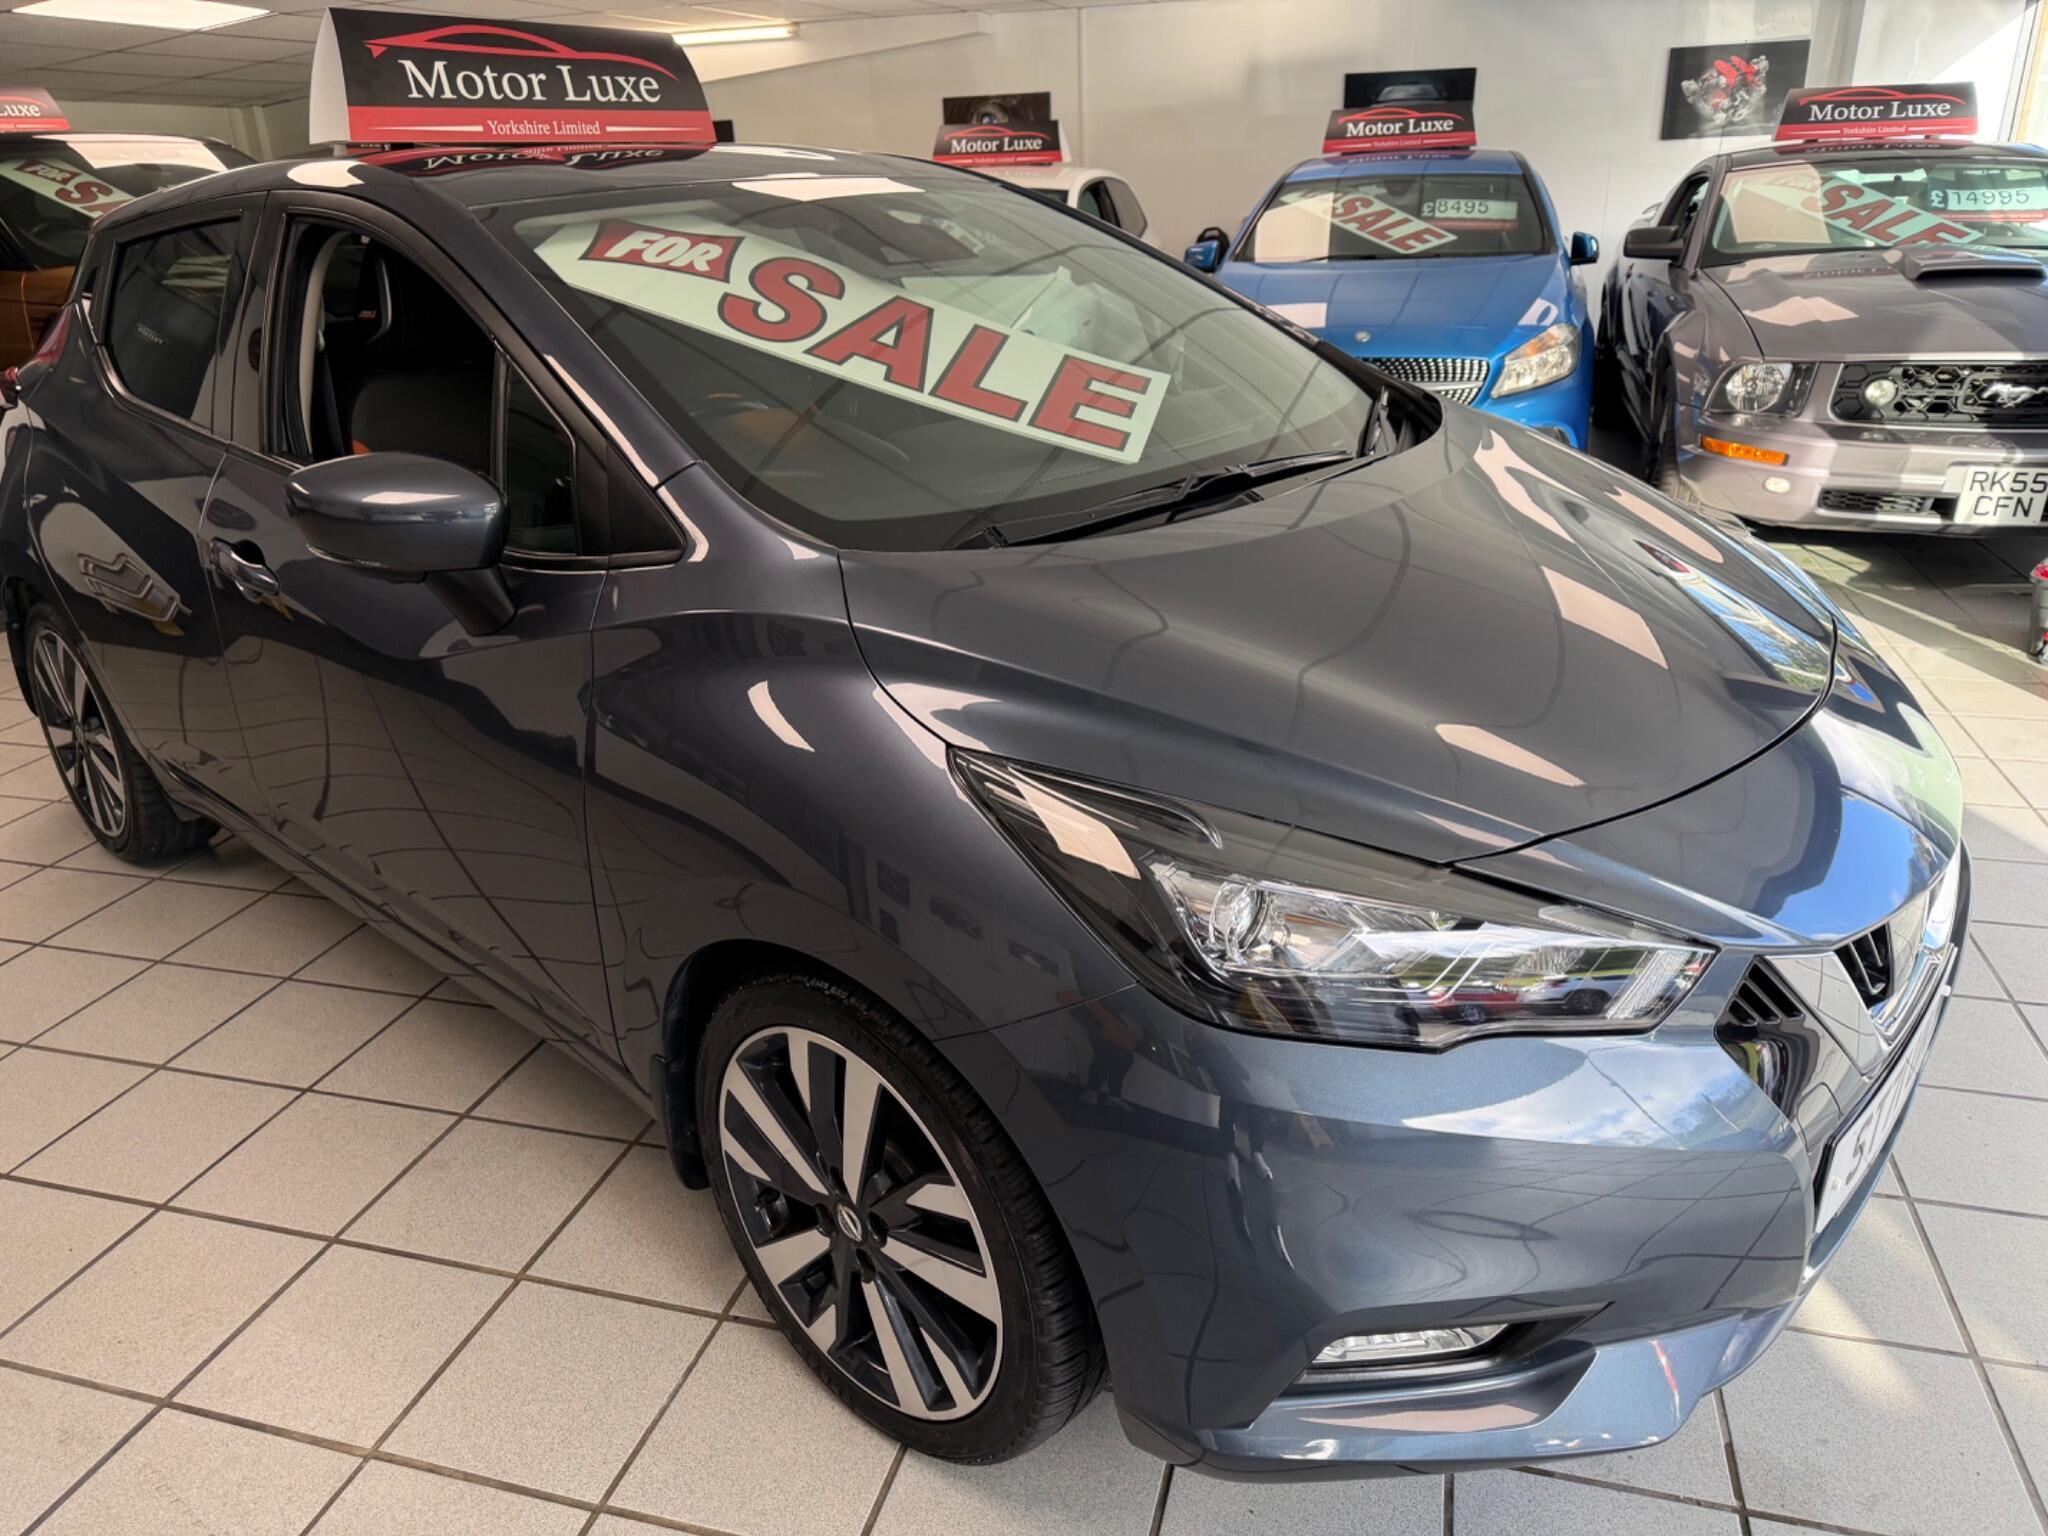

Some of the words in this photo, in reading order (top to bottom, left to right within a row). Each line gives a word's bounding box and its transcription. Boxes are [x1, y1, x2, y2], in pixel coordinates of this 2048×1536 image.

[398, 59, 546, 99] Motor
[556, 64, 662, 103] Luxe
[1808, 103, 1884, 122] Motor
[1890, 101, 1951, 117] Luxe
[486, 119, 551, 136] Yorkshire
[553, 121, 601, 136] Limited
[1345, 121, 1403, 137] Motor
[1408, 118, 1454, 133] Luxe
[950, 138, 1000, 154] Motor
[1003, 137, 1043, 151] Luxe
[1422, 200, 1490, 216] £8495
[1931, 189, 2030, 206] £14995
[1324, 196, 1445, 251] SALE
[1803, 182, 1969, 244] SALE
[603, 230, 726, 272] FOR
[717, 256, 1151, 452] SALE
[1969, 471, 2048, 493] RK55
[1973, 495, 2035, 517] CFN
